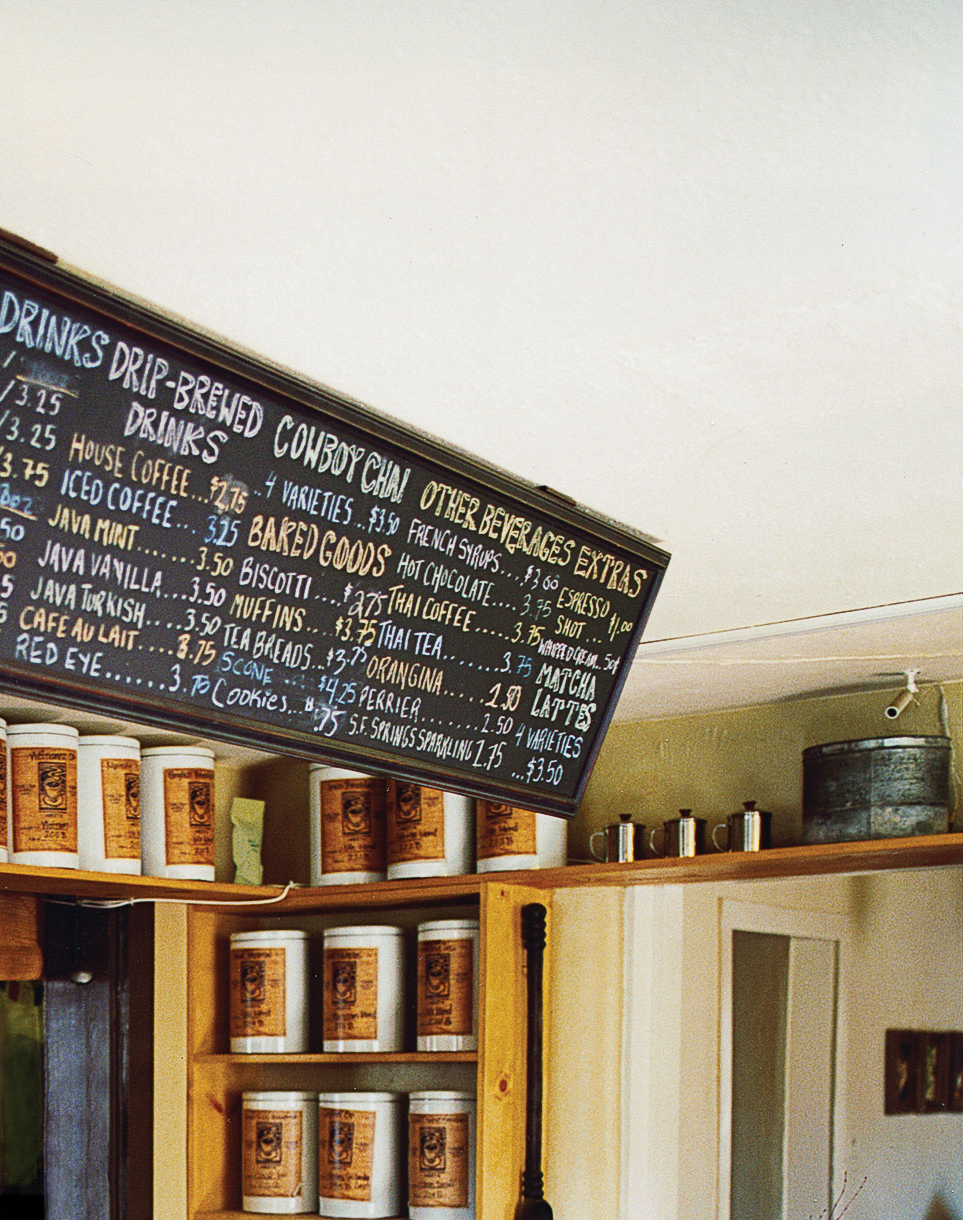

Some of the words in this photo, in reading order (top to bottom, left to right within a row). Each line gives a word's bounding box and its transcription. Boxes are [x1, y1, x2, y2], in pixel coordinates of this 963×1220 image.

[108, 340, 264, 438] DRIP-BREWED
[123, 401, 229, 465] DRINKS
[68, 431, 125, 479] HOUSE
[130, 449, 192, 499] COFFEE
[273, 414, 366, 484] COWBOY
[360, 451, 412, 504] CHAI
[60, 468, 103, 506] ICED
[106, 482, 178, 529] COFFEE
[265, 470, 278, 499] 4
[281, 479, 355, 526] VARIETIES
[47, 503, 91, 541] JAVA
[93, 517, 141, 552] MINT
[247, 514, 319, 561] BAKED
[318, 529, 392, 578] GOODS
[406, 517, 460, 559] FRENCH
[457, 538, 503, 577] SYRUPS
[419, 480, 477, 532] OTHER
[478, 503, 577, 567] BEVERAGES
[38, 539, 86, 576] JAVA
[238, 556, 313, 600] BISCOTTI
[396, 552, 425, 580] HOT
[422, 561, 495, 608] CHOCOLATE
[573, 544, 648, 599] EXTRAS
[30, 575, 77, 611] JAVA
[229, 593, 307, 633] MUFFINS
[388, 584, 420, 617] THAI
[421, 597, 477, 633] COFFEE
[555, 586, 611, 620] ESPRESSO
[18, 605, 71, 639] CAFE
[71, 617, 95, 643] AU
[97, 623, 141, 652] LAIT
[222, 622, 252, 652] TEA
[252, 630, 314, 671] BREADS
[377, 620, 412, 651] THAI
[413, 631, 444, 661] TEA
[553, 614, 587, 640] SHOT
[14, 632, 59, 666] RED
[64, 646, 104, 678] EYE
[366, 655, 444, 697] ORANGINA
[357, 685, 422, 723] PERRIER
[534, 661, 598, 703] MATCHA
[529, 687, 598, 735] LATTES
[370, 715, 416, 752] SPRINGS
[415, 727, 474, 763] SPARKLING
[515, 722, 526, 747] 4
[525, 726, 585, 759] VARIETIES
